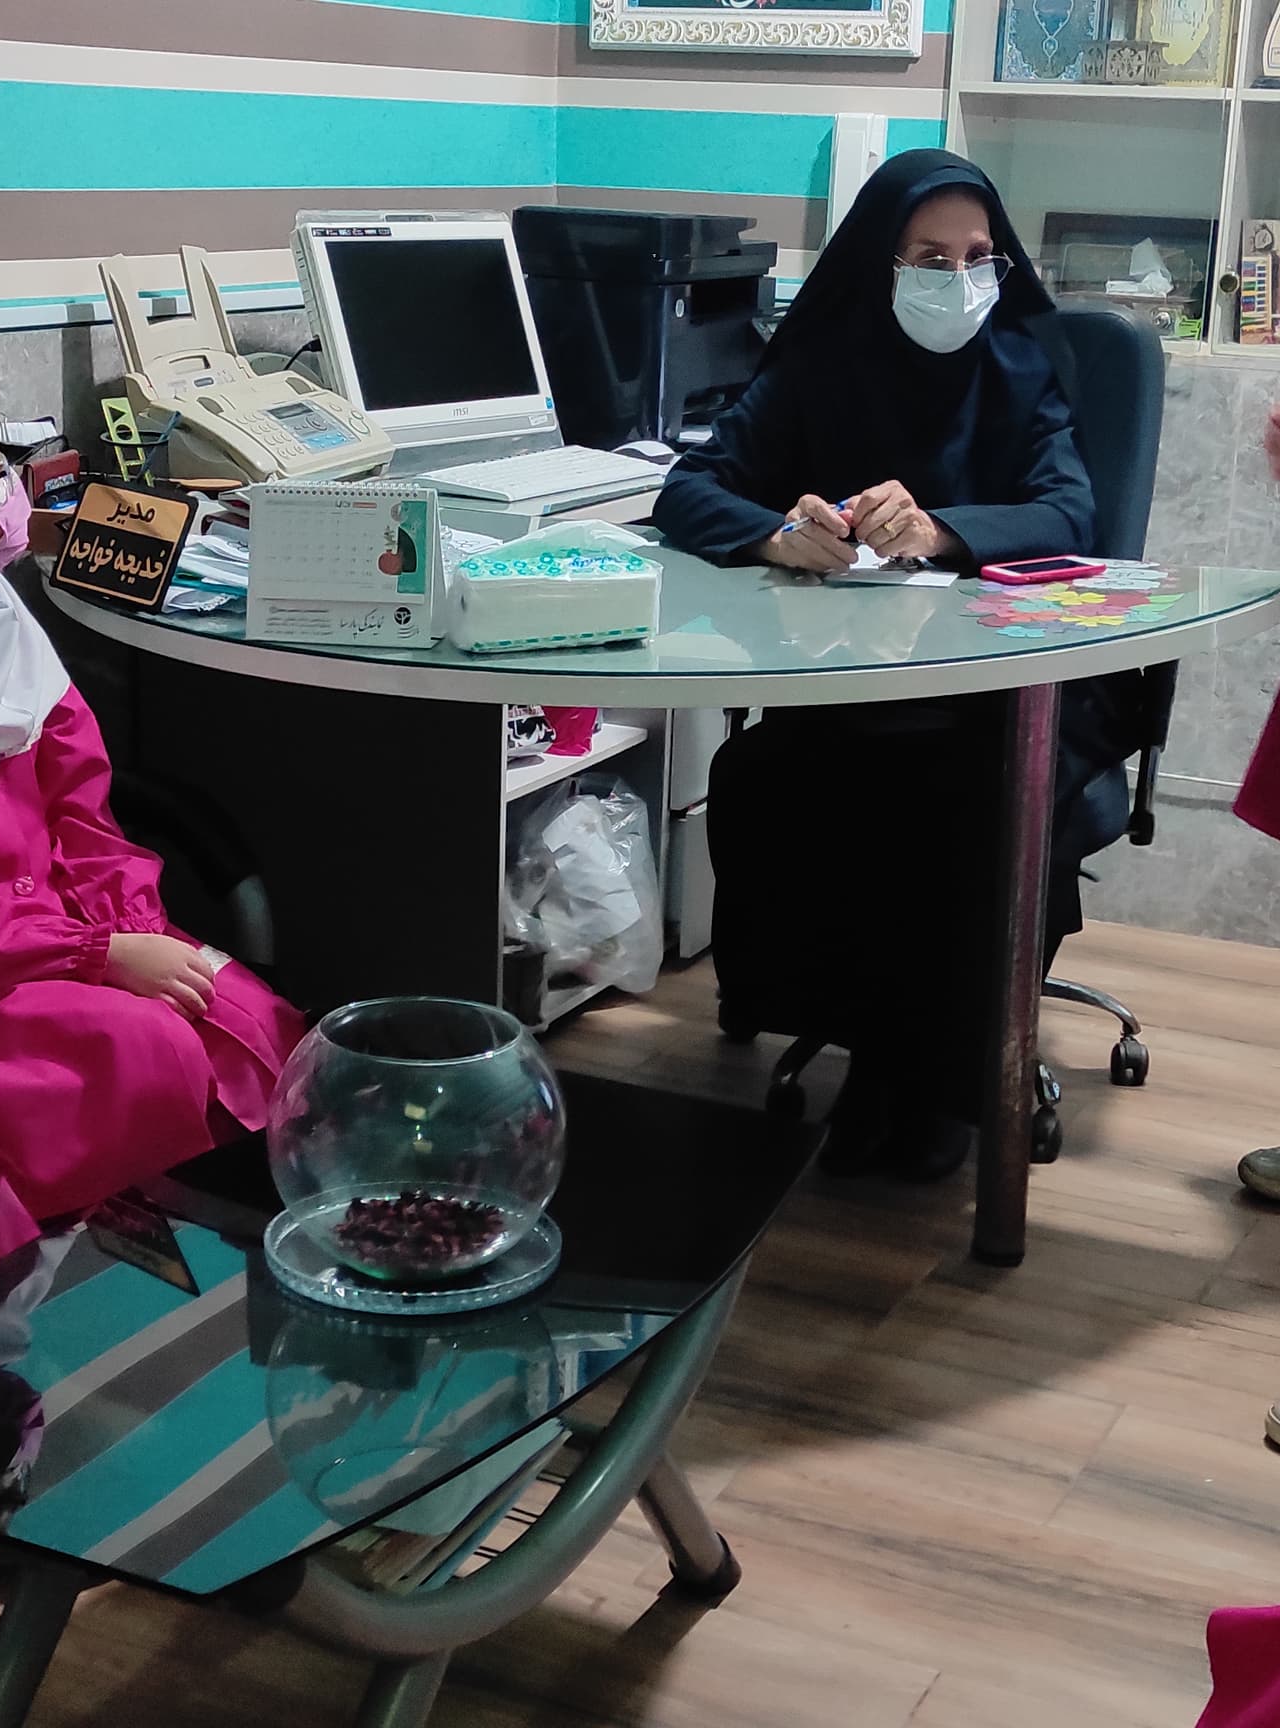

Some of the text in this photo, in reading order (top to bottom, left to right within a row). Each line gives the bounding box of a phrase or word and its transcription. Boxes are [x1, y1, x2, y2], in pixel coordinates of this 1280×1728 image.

[106, 502, 155, 525] مدیر
[70, 535, 166, 584] خدیجه خواجه
